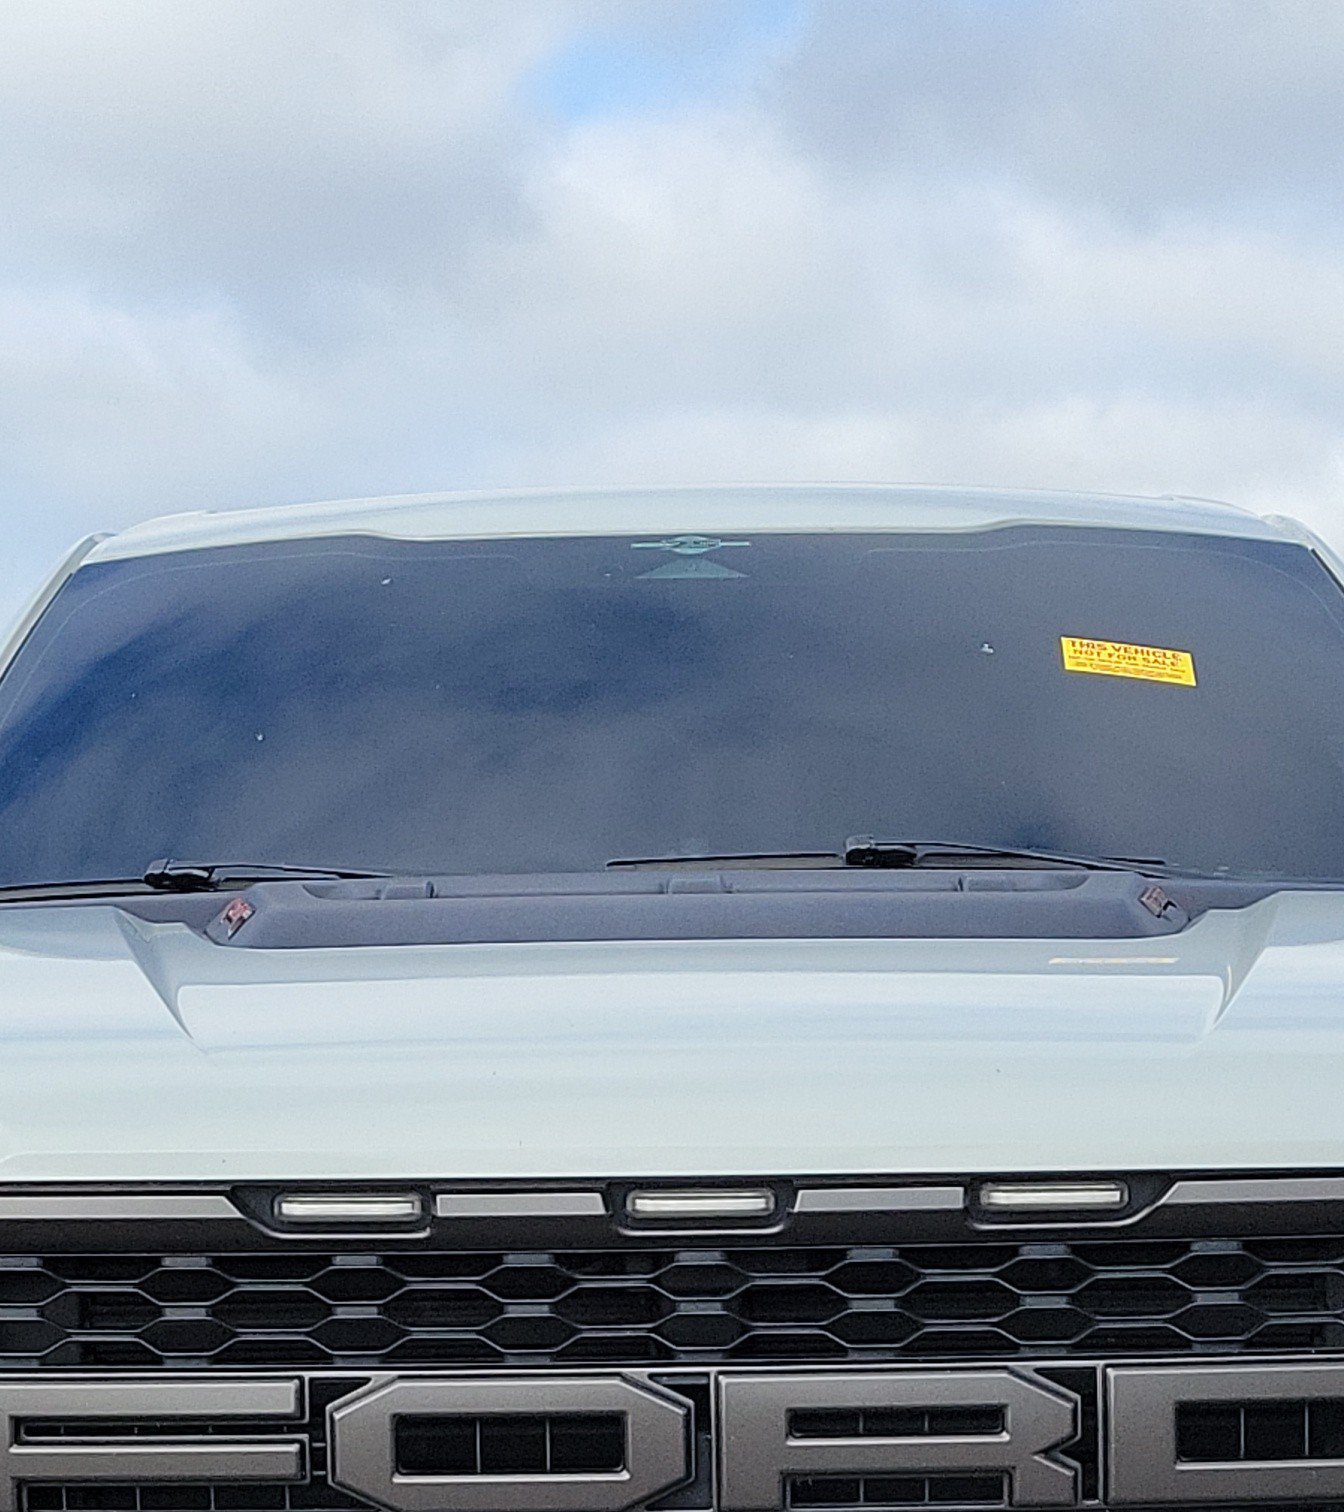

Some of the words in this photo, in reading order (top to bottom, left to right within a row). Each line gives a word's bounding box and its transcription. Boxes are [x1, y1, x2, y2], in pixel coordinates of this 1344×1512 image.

[1069, 640, 1107, 651] THIS
[1111, 645, 1180, 660] VEHICLE
[1073, 649, 1102, 659] NOT
[1108, 652, 1137, 662] FOR
[1142, 657, 1179, 667] SALE
